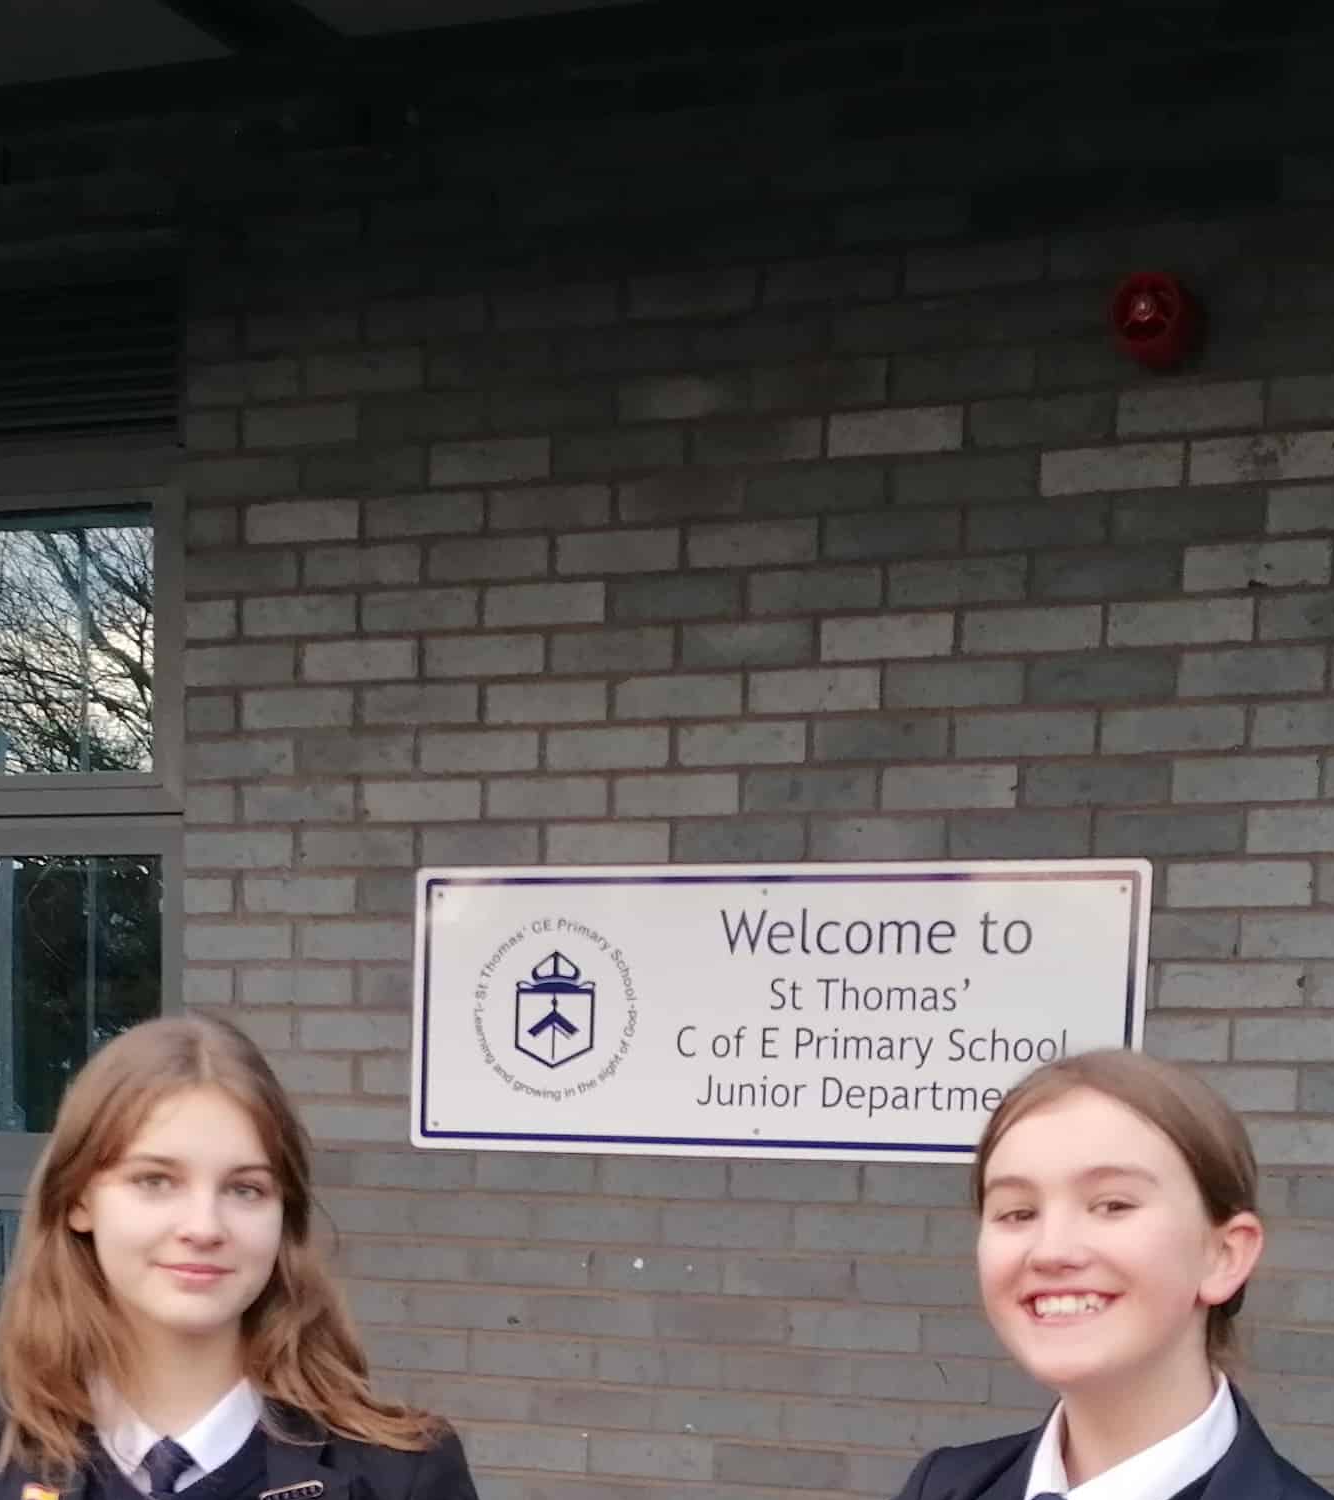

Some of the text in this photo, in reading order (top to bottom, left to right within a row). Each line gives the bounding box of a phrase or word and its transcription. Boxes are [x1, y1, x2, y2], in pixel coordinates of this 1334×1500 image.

[556, 917, 612, 951] Primary
[720, 908, 1033, 955] Welcome to
[770, 977, 971, 1012] St Thomas’
[676, 1025, 1068, 1070] C of E Primary School
[492, 1064, 515, 1084] and
[513, 1079, 562, 1102] growing
[564, 1087, 576, 1098] in
[577, 1078, 598, 1094] the
[597, 1052, 624, 1082] sight
[620, 1039, 632, 1055] of
[697, 1074, 1003, 1118] Junior Departme
